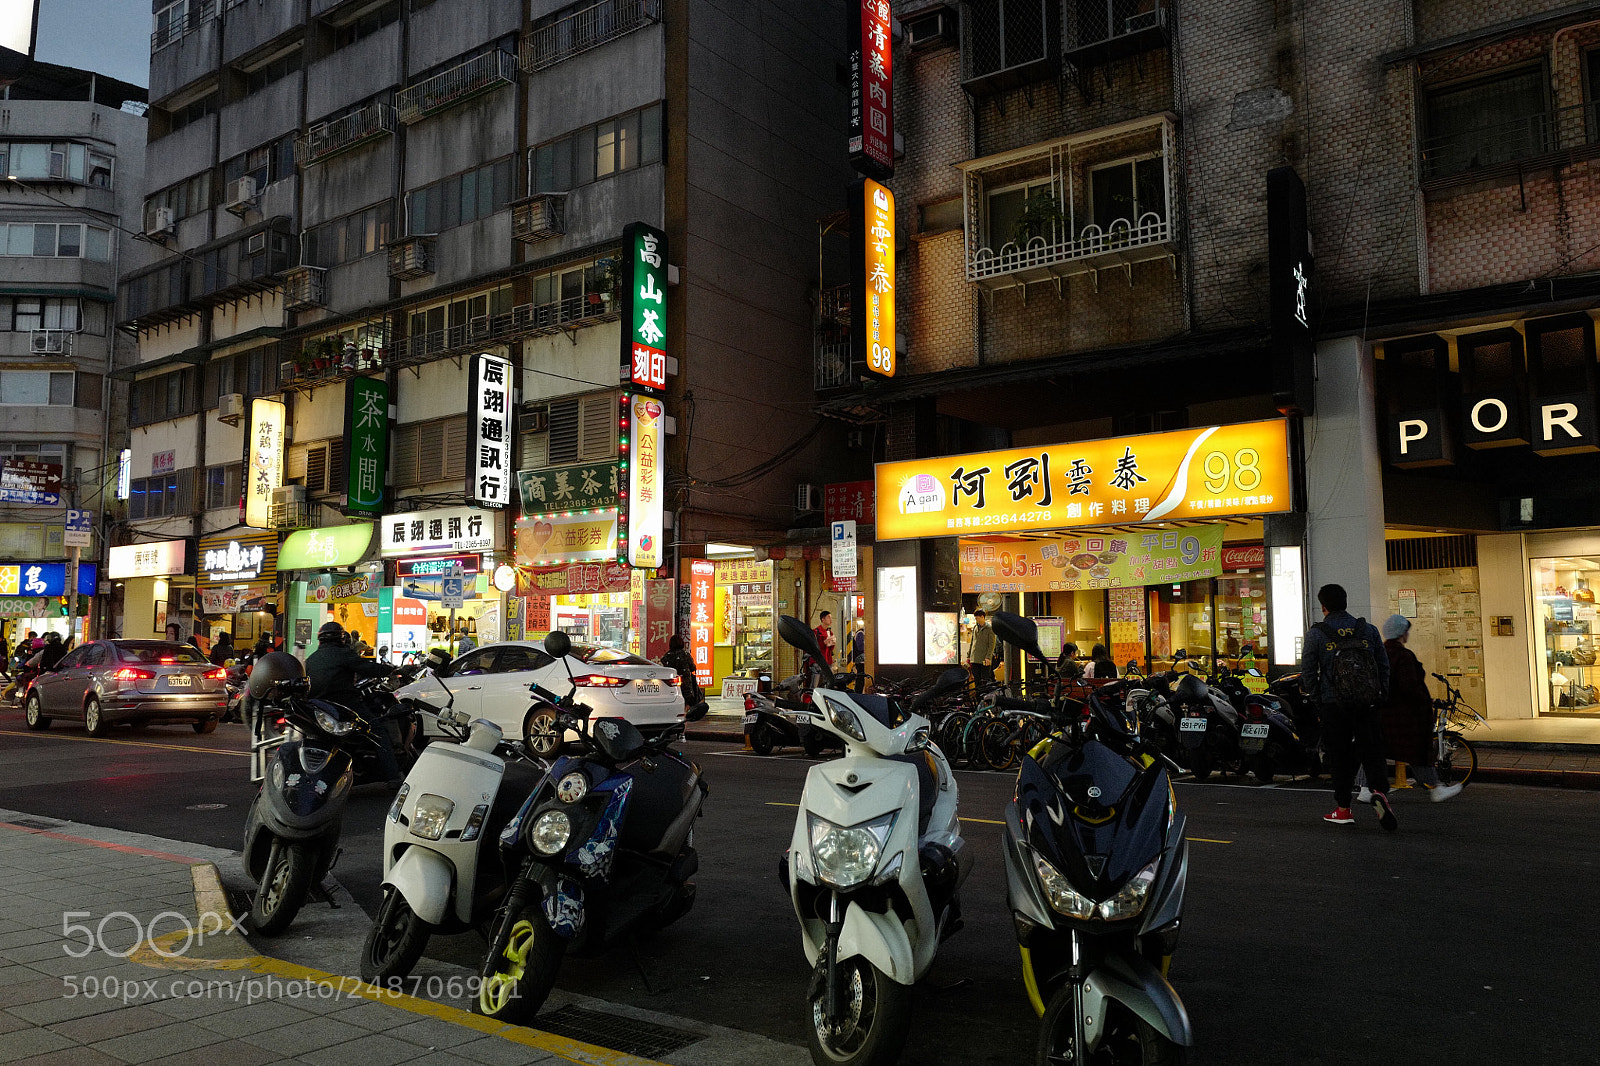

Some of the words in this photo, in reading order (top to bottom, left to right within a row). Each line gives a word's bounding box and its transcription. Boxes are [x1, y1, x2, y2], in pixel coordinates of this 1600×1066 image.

[868, 20, 888, 137] 清蒸肉圓
[638, 232, 664, 344] 高山茶
[633, 347, 666, 386] 刻印
[872, 342, 892, 372] 98
[480, 359, 504, 499] 辰翊通訊行
[356, 389, 384, 503] 茶水間
[640, 434, 654, 503] 公益彩券
[1204, 447, 1262, 494] 98
[482, 501, 503, 509] TELECOM
[919, 493, 938, 505] gan
[1066, 497, 1151, 518] 創作料理
[67, 510, 80, 524] P
[392, 515, 483, 543] 辰翊通訊行
[553, 527, 602, 546] 公益彩券
[834, 527, 842, 538] P
[1140, 531, 1179, 552] 平日
[965, 546, 995, 562] 假日
[1041, 538, 1128, 560] 開學回饋
[446, 568, 452, 576] P
[650, 582, 670, 667] 普洱
[695, 580, 710, 665] 清蒸肉圓
